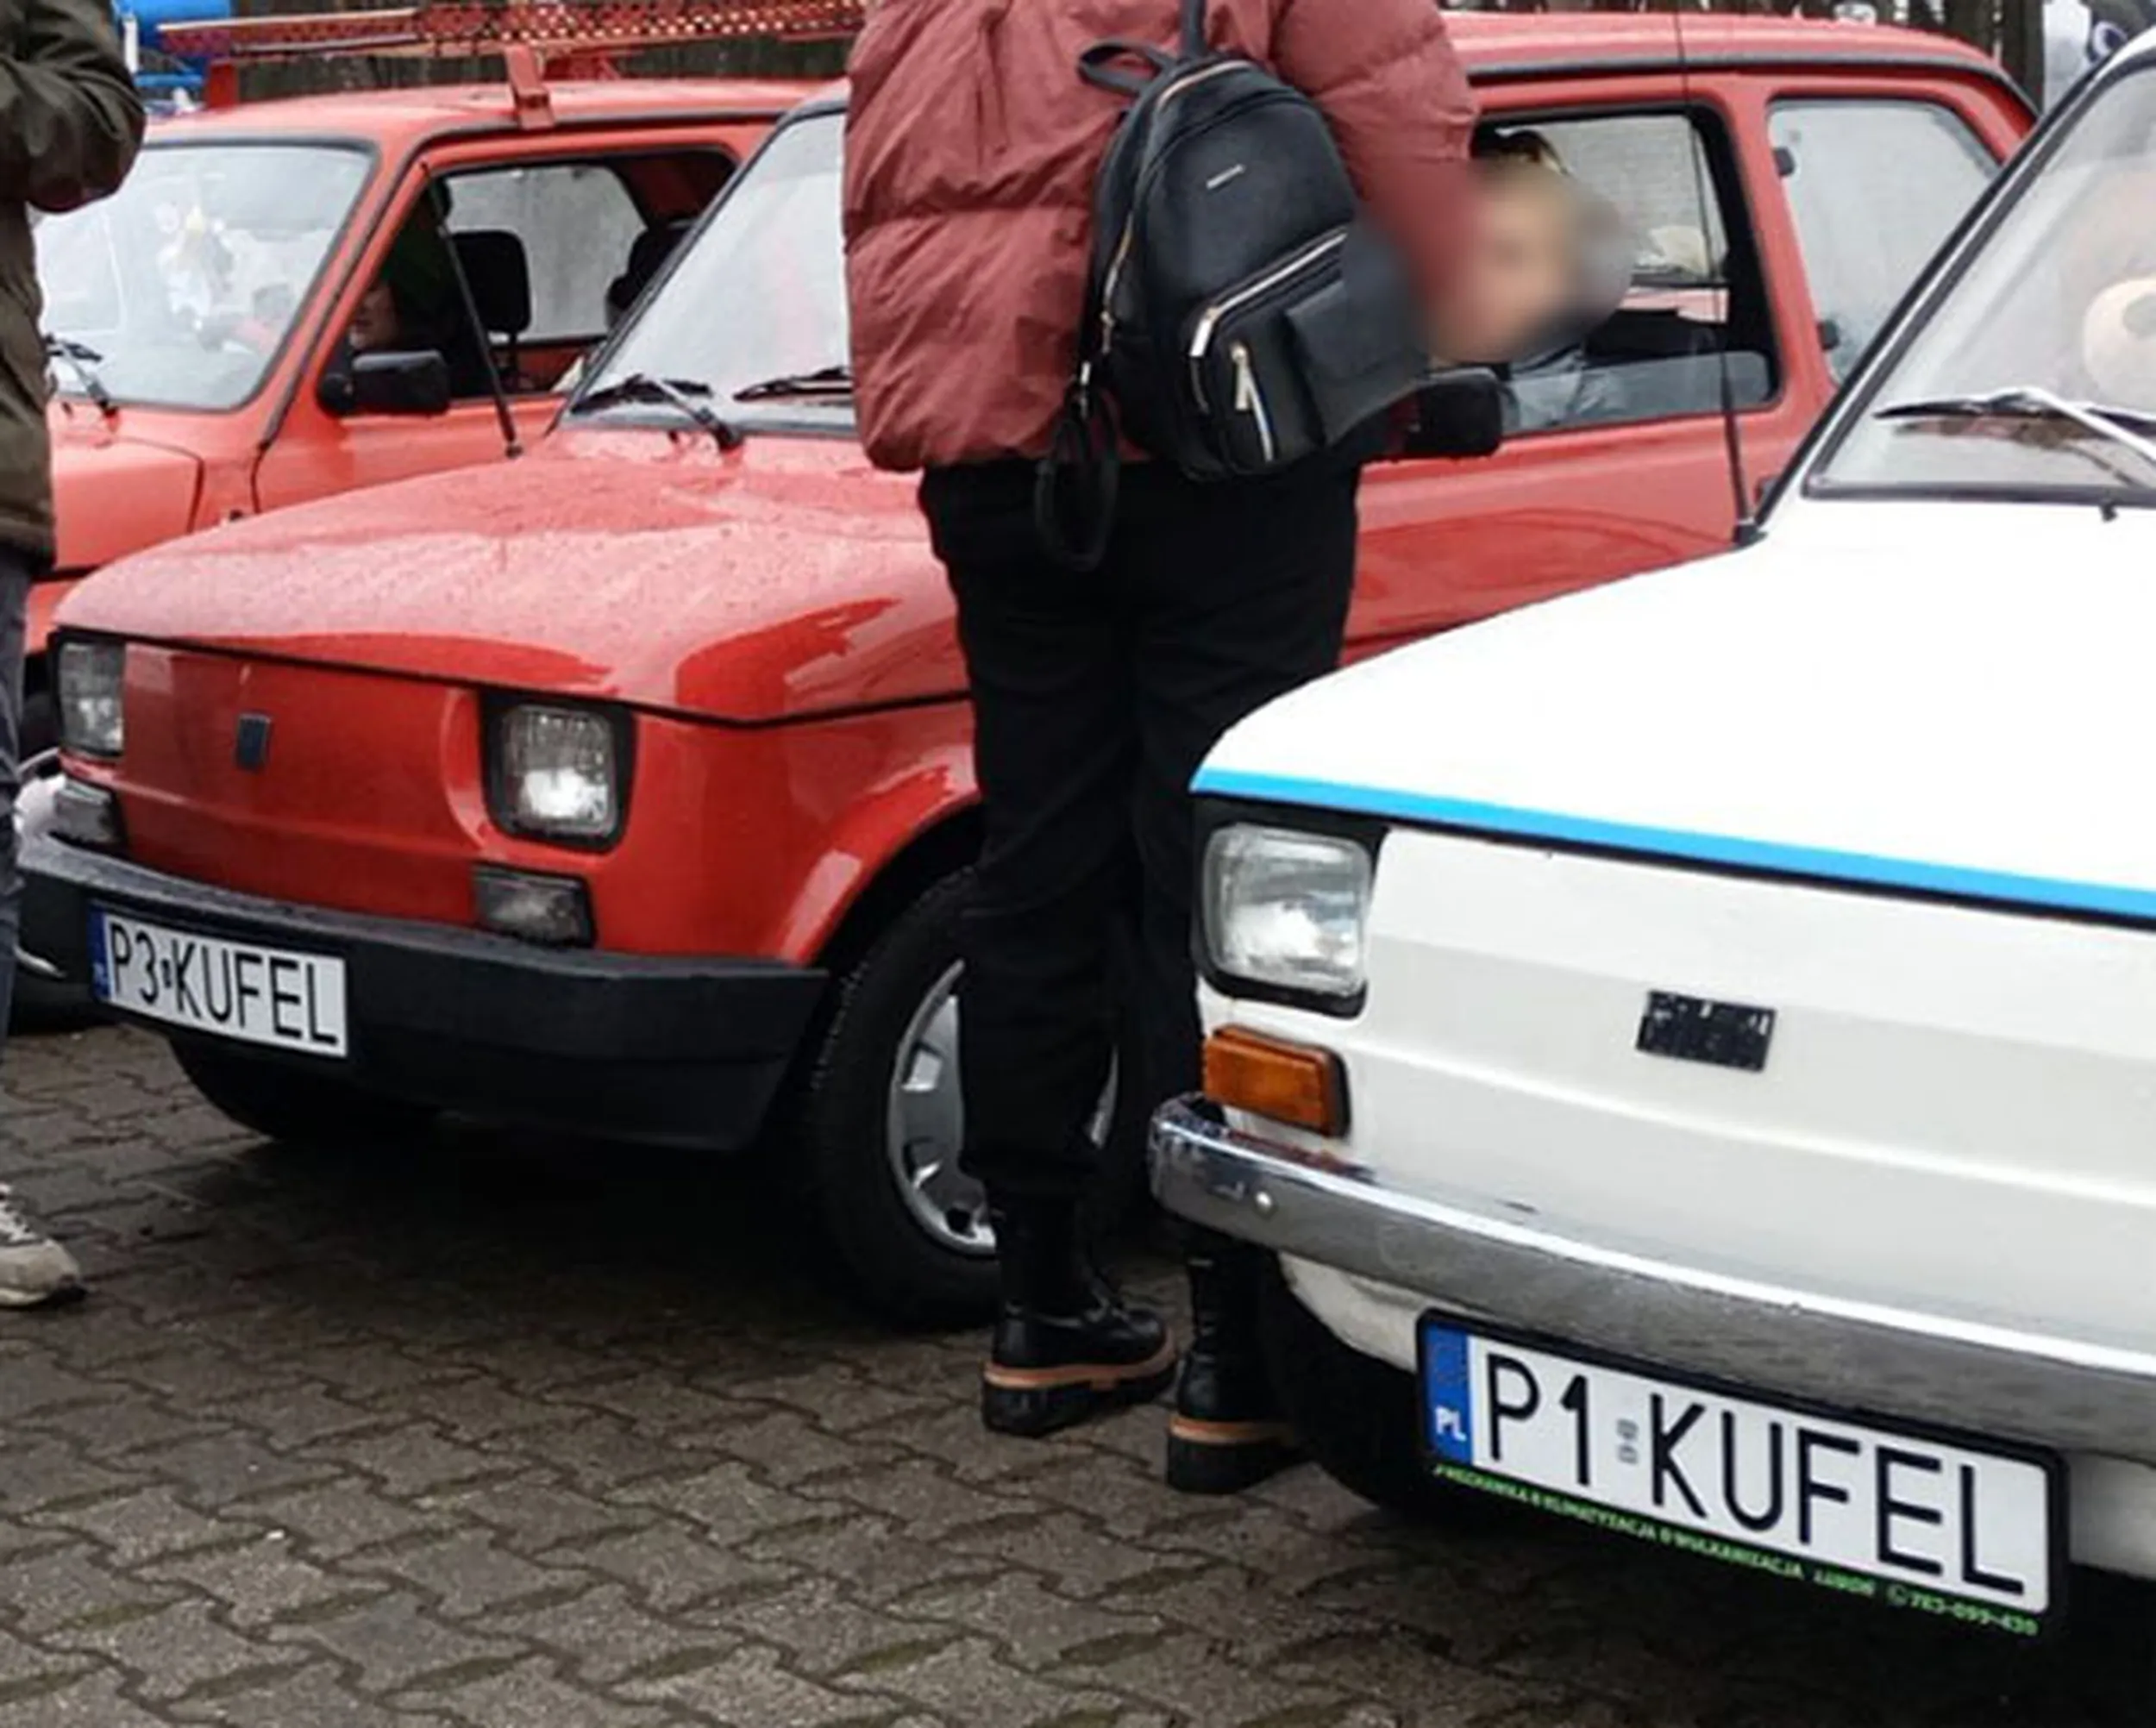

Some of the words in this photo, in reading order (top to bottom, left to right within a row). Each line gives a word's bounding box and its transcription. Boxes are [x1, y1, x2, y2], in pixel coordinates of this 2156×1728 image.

[110, 923, 159, 1004] P3
[172, 939, 337, 1044] KUFEL
[1435, 1406, 1466, 1442] PL
[1486, 1353, 1590, 1486] P1
[1651, 1393, 2025, 1595] KUFEL
